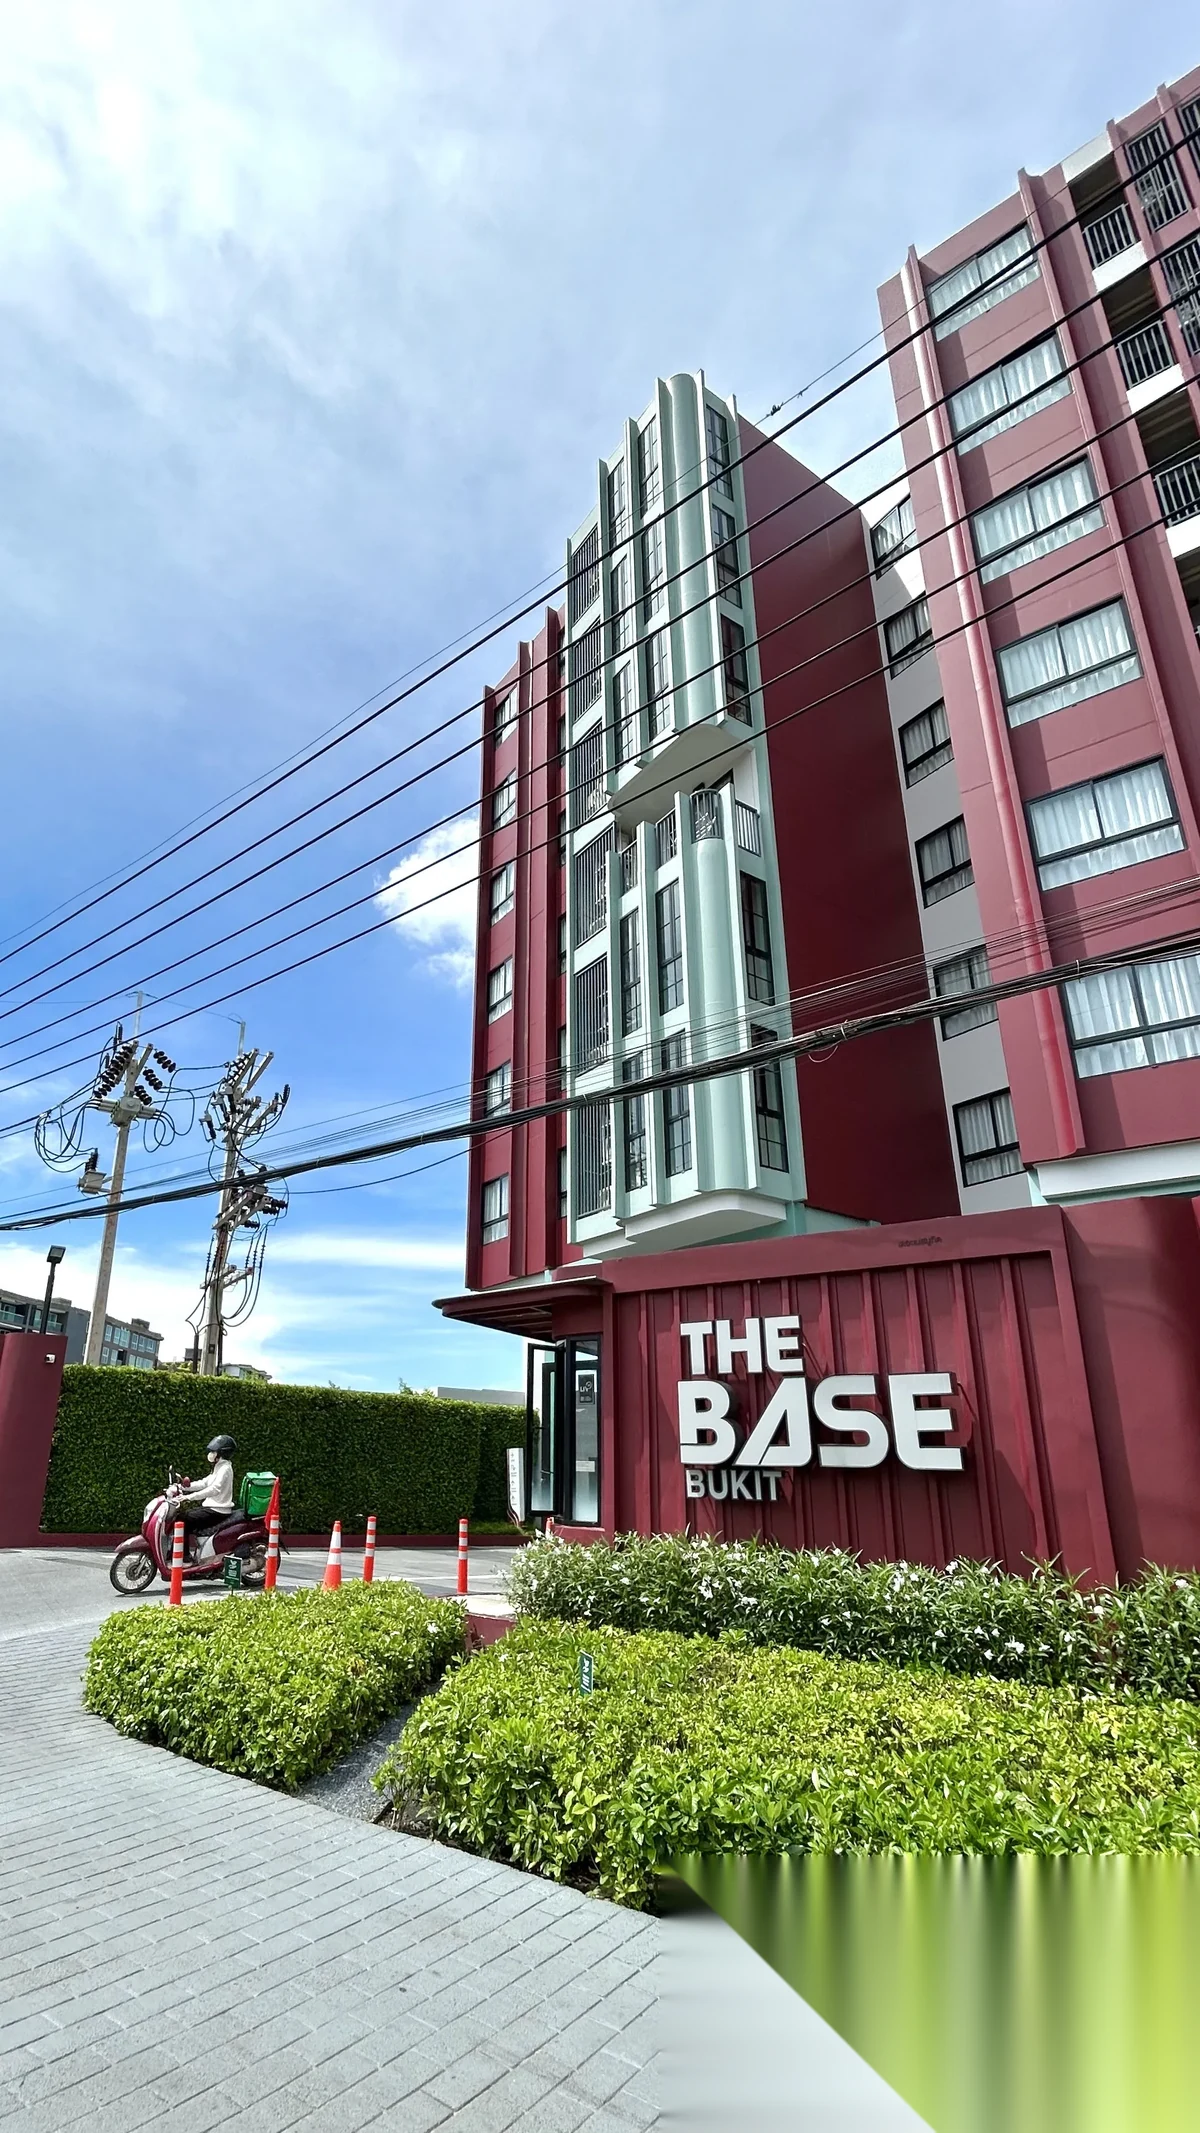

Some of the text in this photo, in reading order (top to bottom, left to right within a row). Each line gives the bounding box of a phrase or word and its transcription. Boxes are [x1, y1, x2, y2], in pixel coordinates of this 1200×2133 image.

[680, 1315, 804, 1375] THE
[677, 1373, 963, 1470] BASE
[686, 1469, 782, 1501] BUKIT
